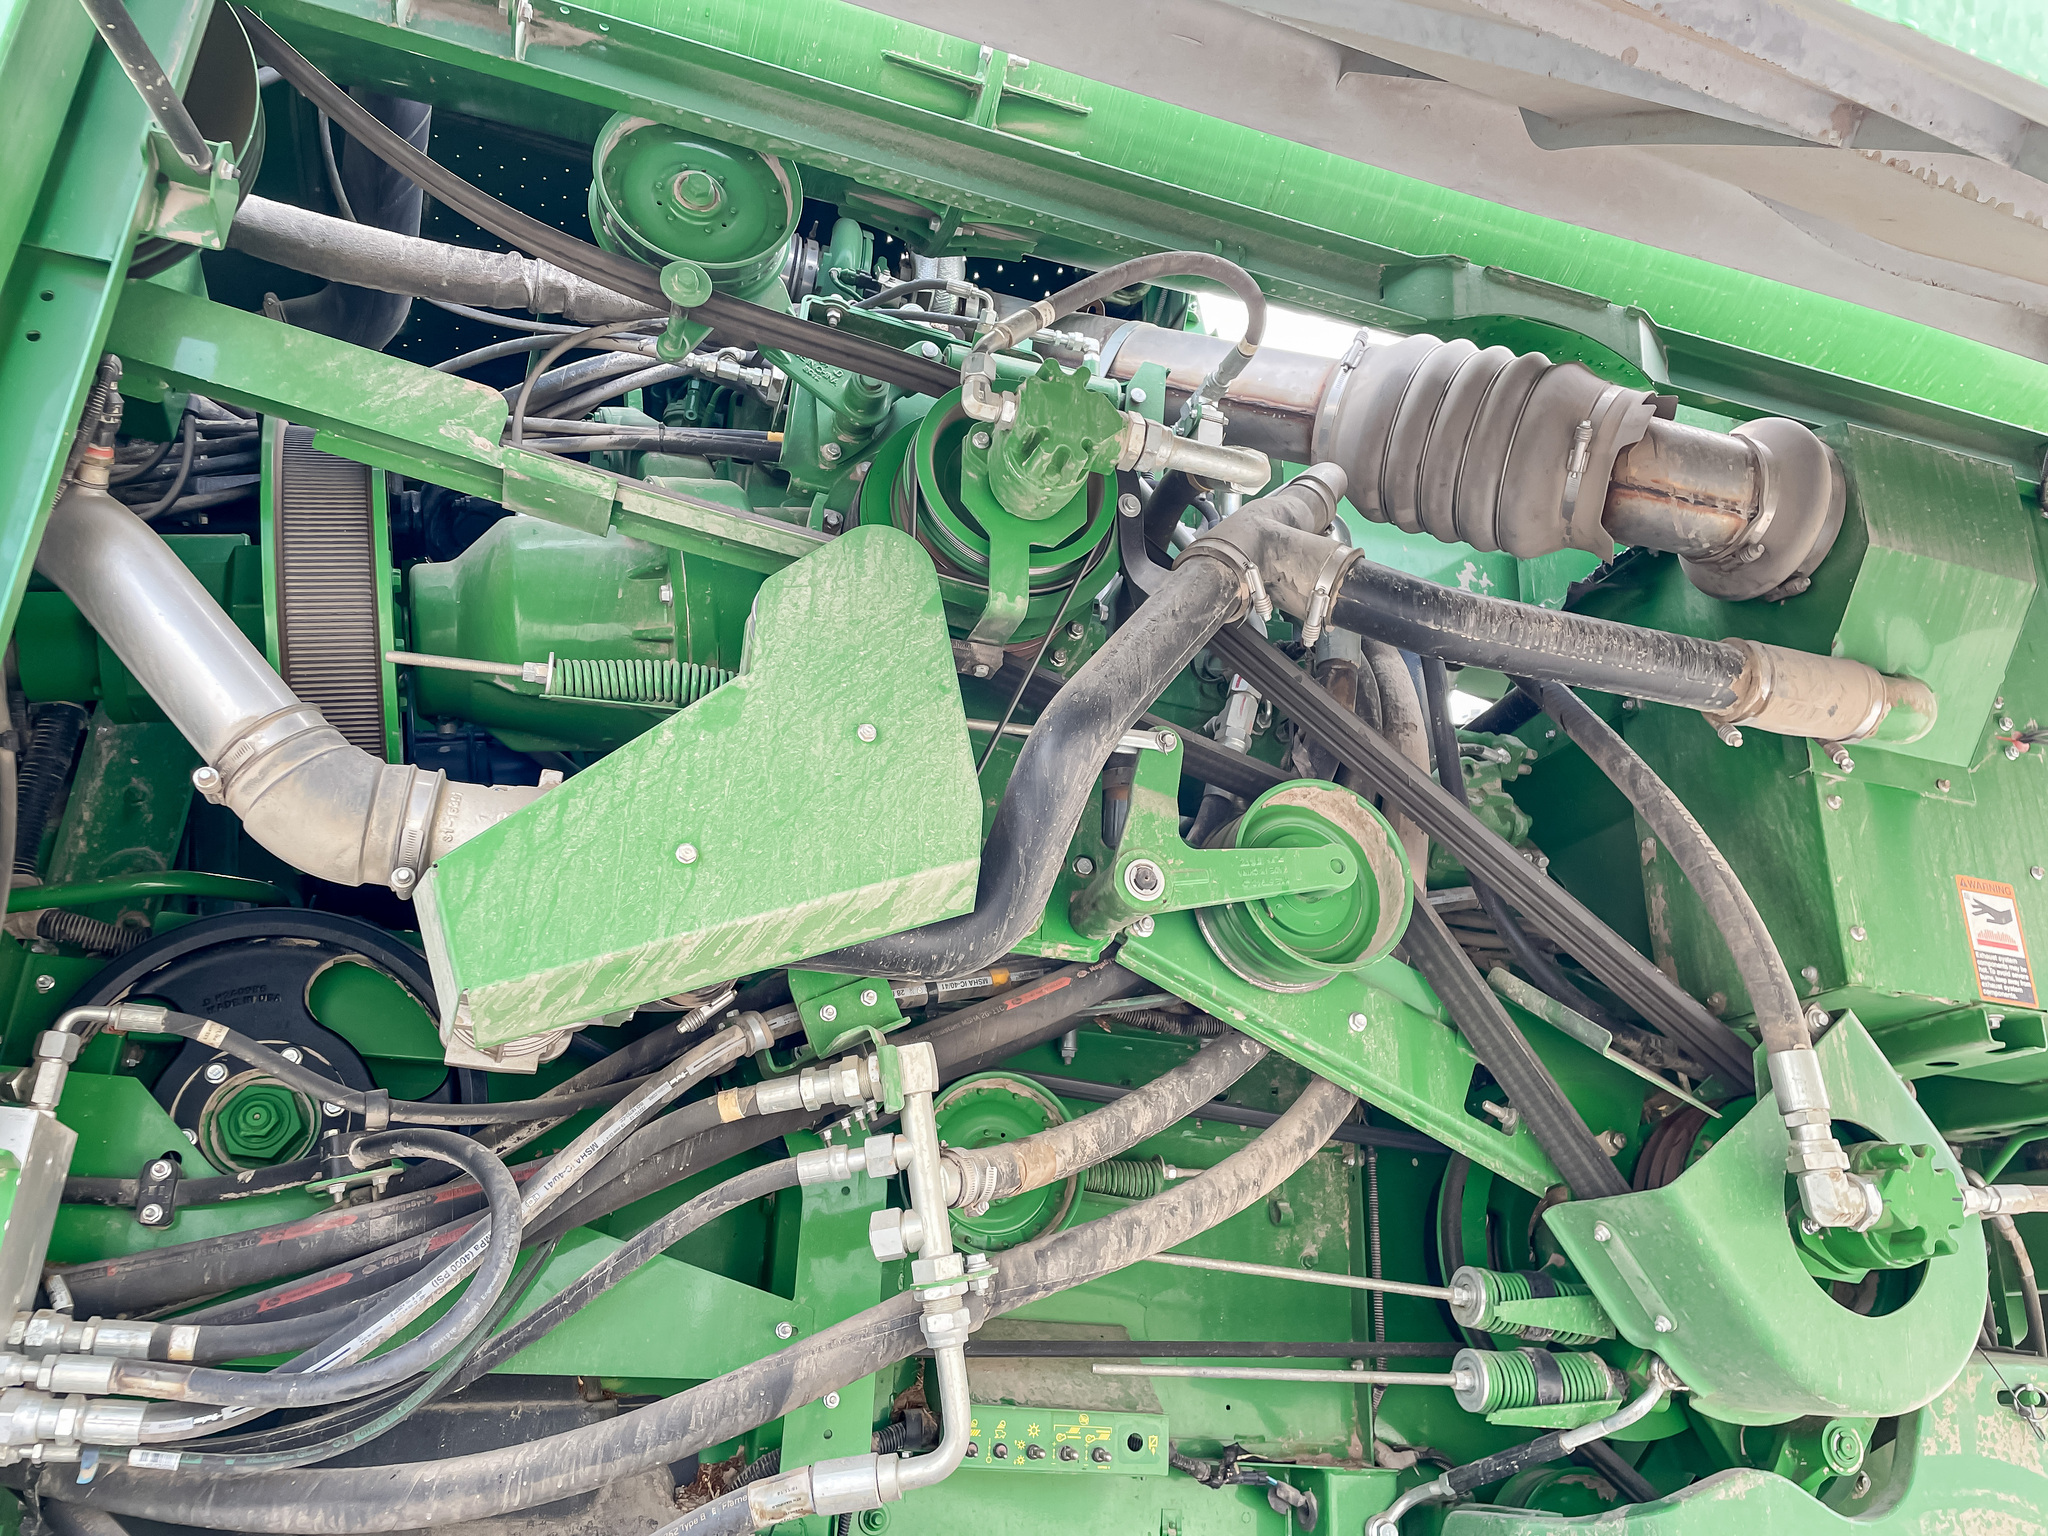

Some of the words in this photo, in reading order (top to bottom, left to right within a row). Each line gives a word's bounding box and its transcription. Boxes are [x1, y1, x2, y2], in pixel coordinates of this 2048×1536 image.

[813, 364, 840, 387] CHINA
[1967, 880, 2011, 895] WARNING
[1976, 952, 1997, 961] Exhaust
[1999, 956, 2017, 964] system
[1977, 960, 2008, 970] components
[2009, 965, 2019, 973] may
[940, 979, 967, 991] IC-40/41
[967, 977, 988, 988] MSHA
[1982, 981, 2003, 990] exhaust
[2004, 985, 2023, 993] system
[205, 997, 240, 1014] MADE
[573, 1141, 599, 1165] MSHA
[448, 1249, 475, 1273] (4000
[429, 1269, 451, 1289] PSI)
[678, 1516, 700, 1532] Type
[698, 1511, 707, 1521] B
[719, 1493, 749, 1510] Flame
